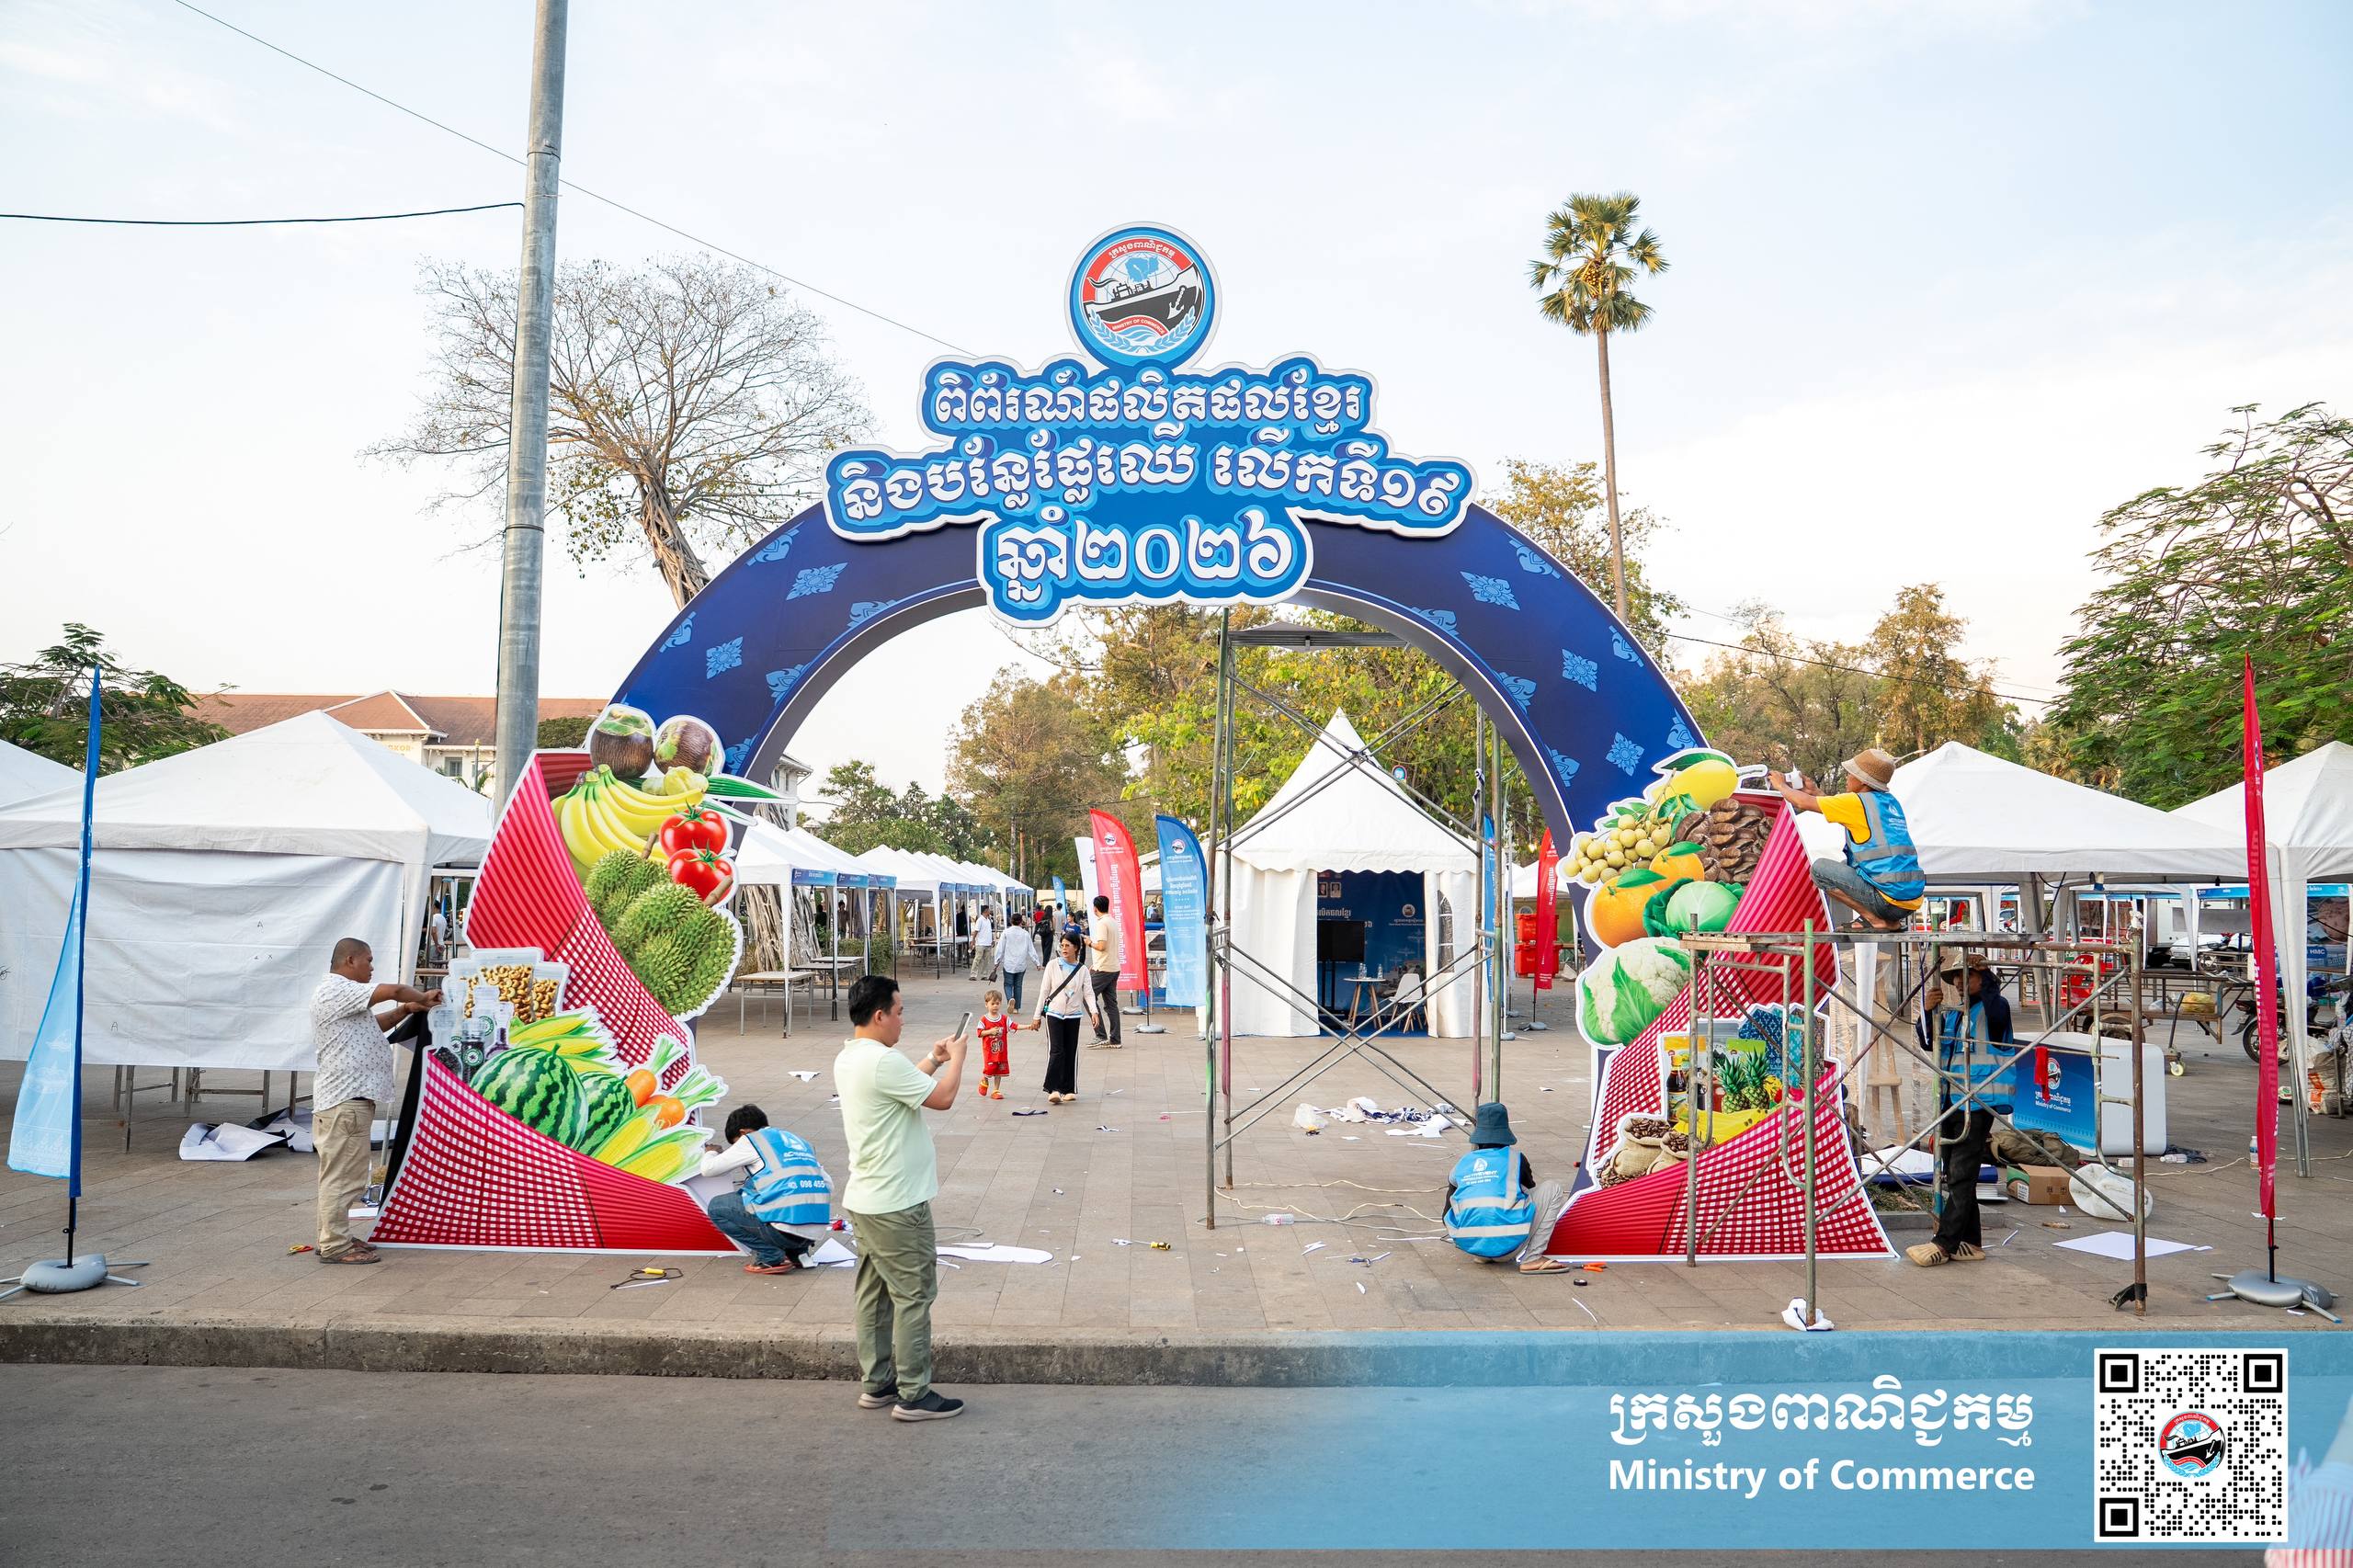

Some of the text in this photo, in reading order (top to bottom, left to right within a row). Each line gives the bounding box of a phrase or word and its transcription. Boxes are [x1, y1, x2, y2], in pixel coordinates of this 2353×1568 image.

[935, 369, 1362, 434] ពិព័រណ៍ផលិតផលខ្មែរ
[1214, 426, 1461, 515] លើកទី១៩
[997, 506, 1292, 602] ឆ្នាំ២០២៦
